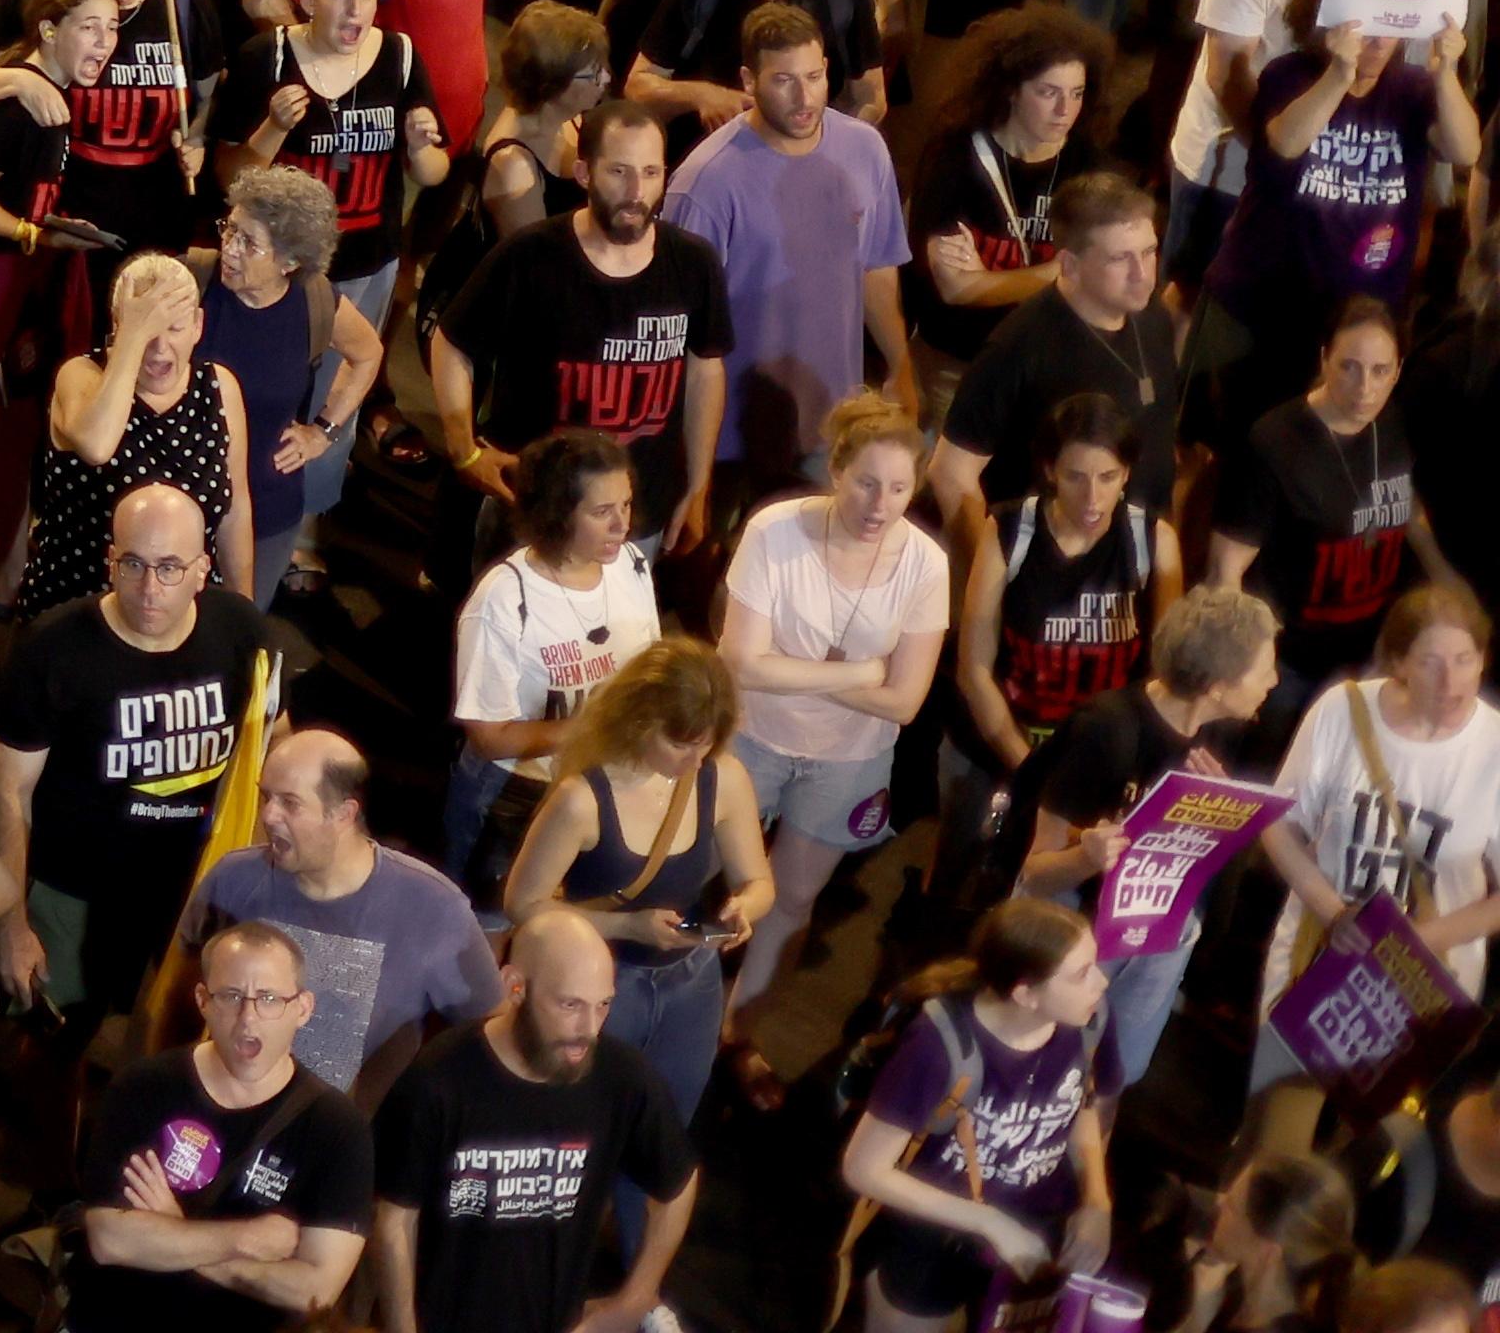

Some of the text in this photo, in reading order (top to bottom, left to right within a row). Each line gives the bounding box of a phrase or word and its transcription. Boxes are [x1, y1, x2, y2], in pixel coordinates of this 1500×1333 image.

[539, 639, 582, 667] BRING
[547, 652, 619, 688] THEM HOME
[120, 680, 227, 740] בוחרים
[105, 725, 236, 779] בחטופים
[558, 1149, 588, 1170] אין
[495, 1174, 582, 1198] עם כיבוש
